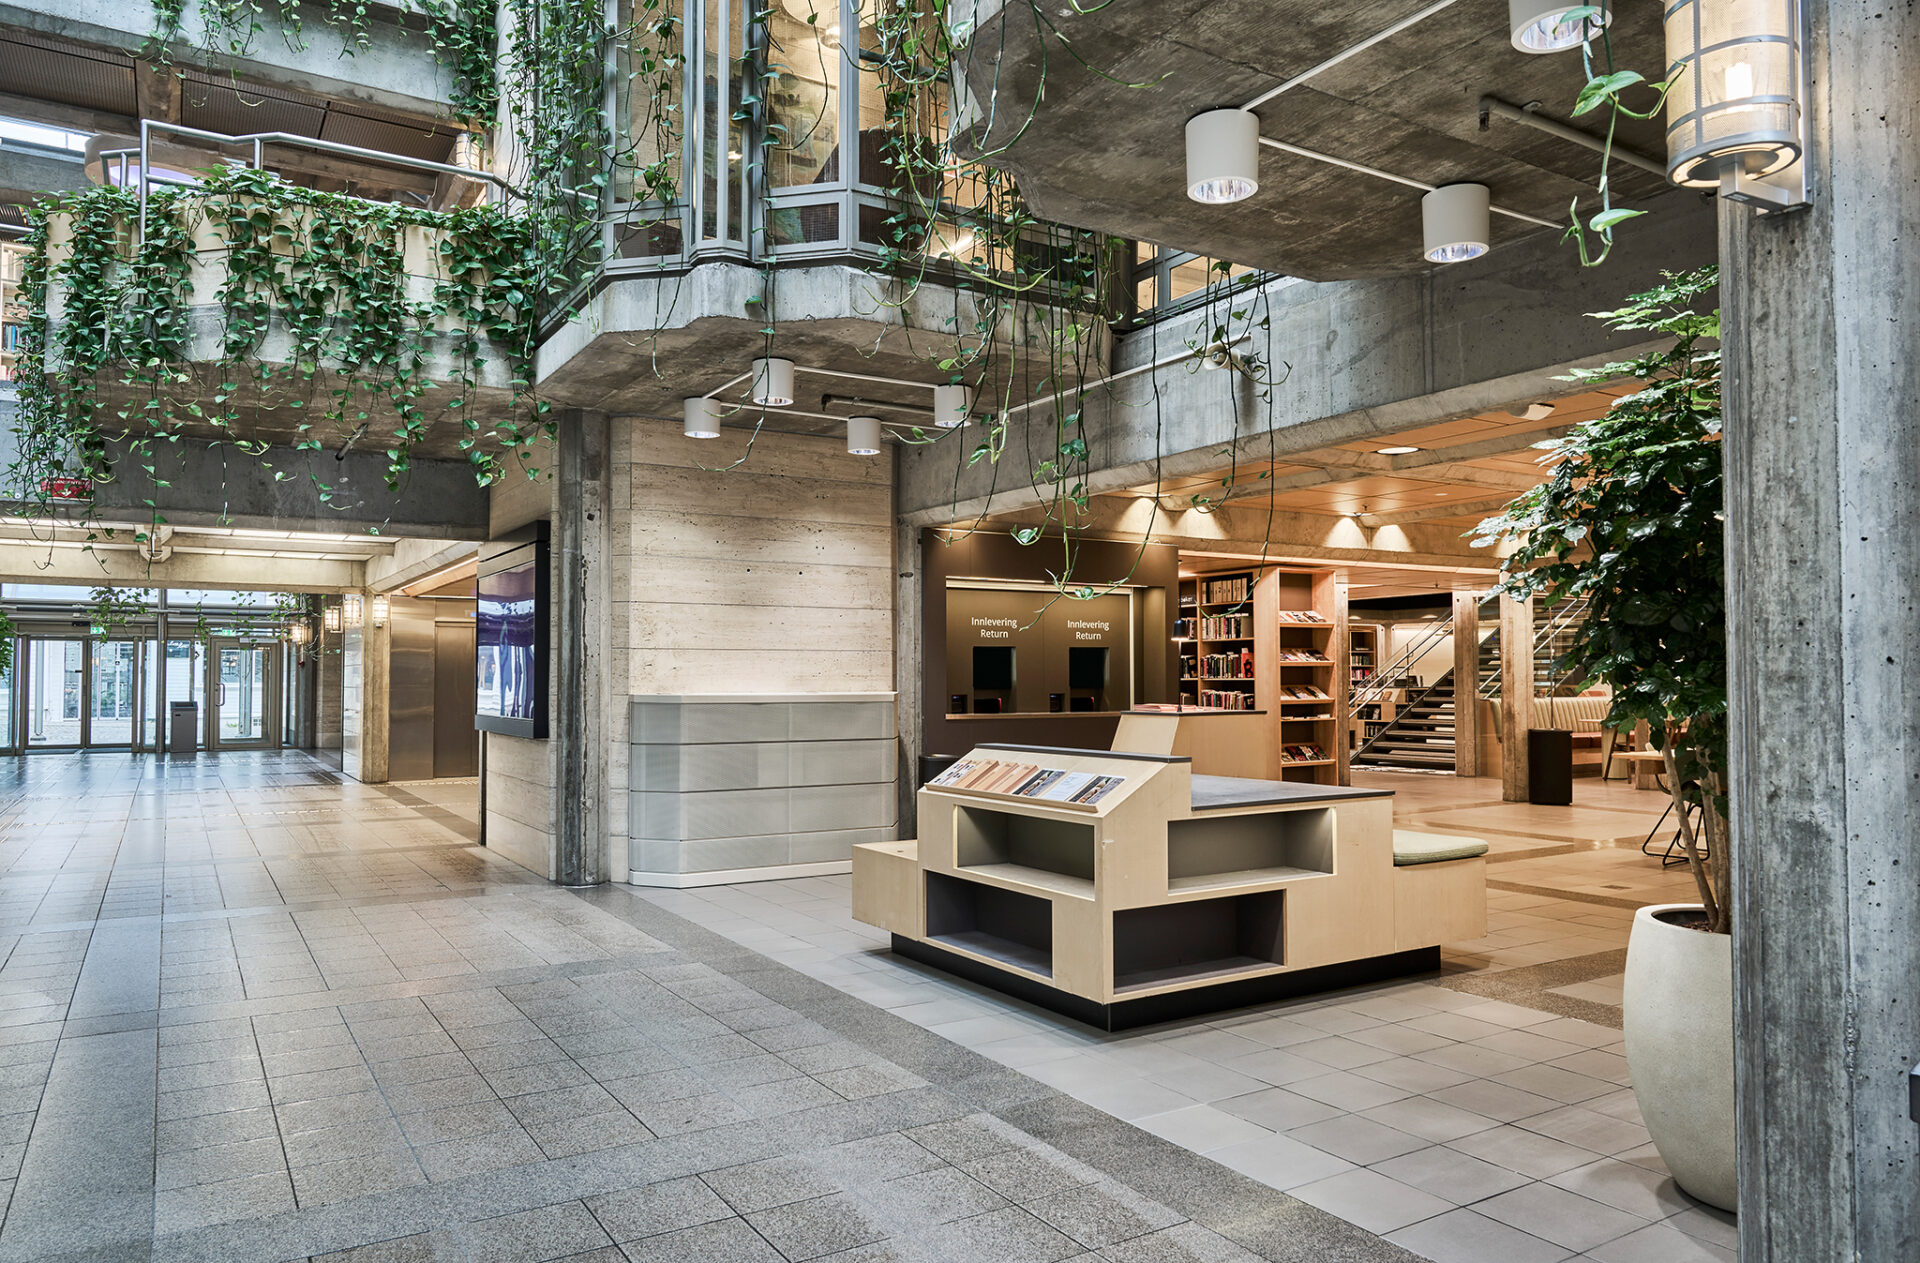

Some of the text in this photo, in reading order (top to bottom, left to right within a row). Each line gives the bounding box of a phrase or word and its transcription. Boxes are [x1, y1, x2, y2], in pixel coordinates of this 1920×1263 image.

[971, 616, 1018, 629] Innlevering
[1067, 619, 1110, 631] Innlevering
[980, 629, 1009, 638] Return
[1075, 631, 1102, 640] Return
